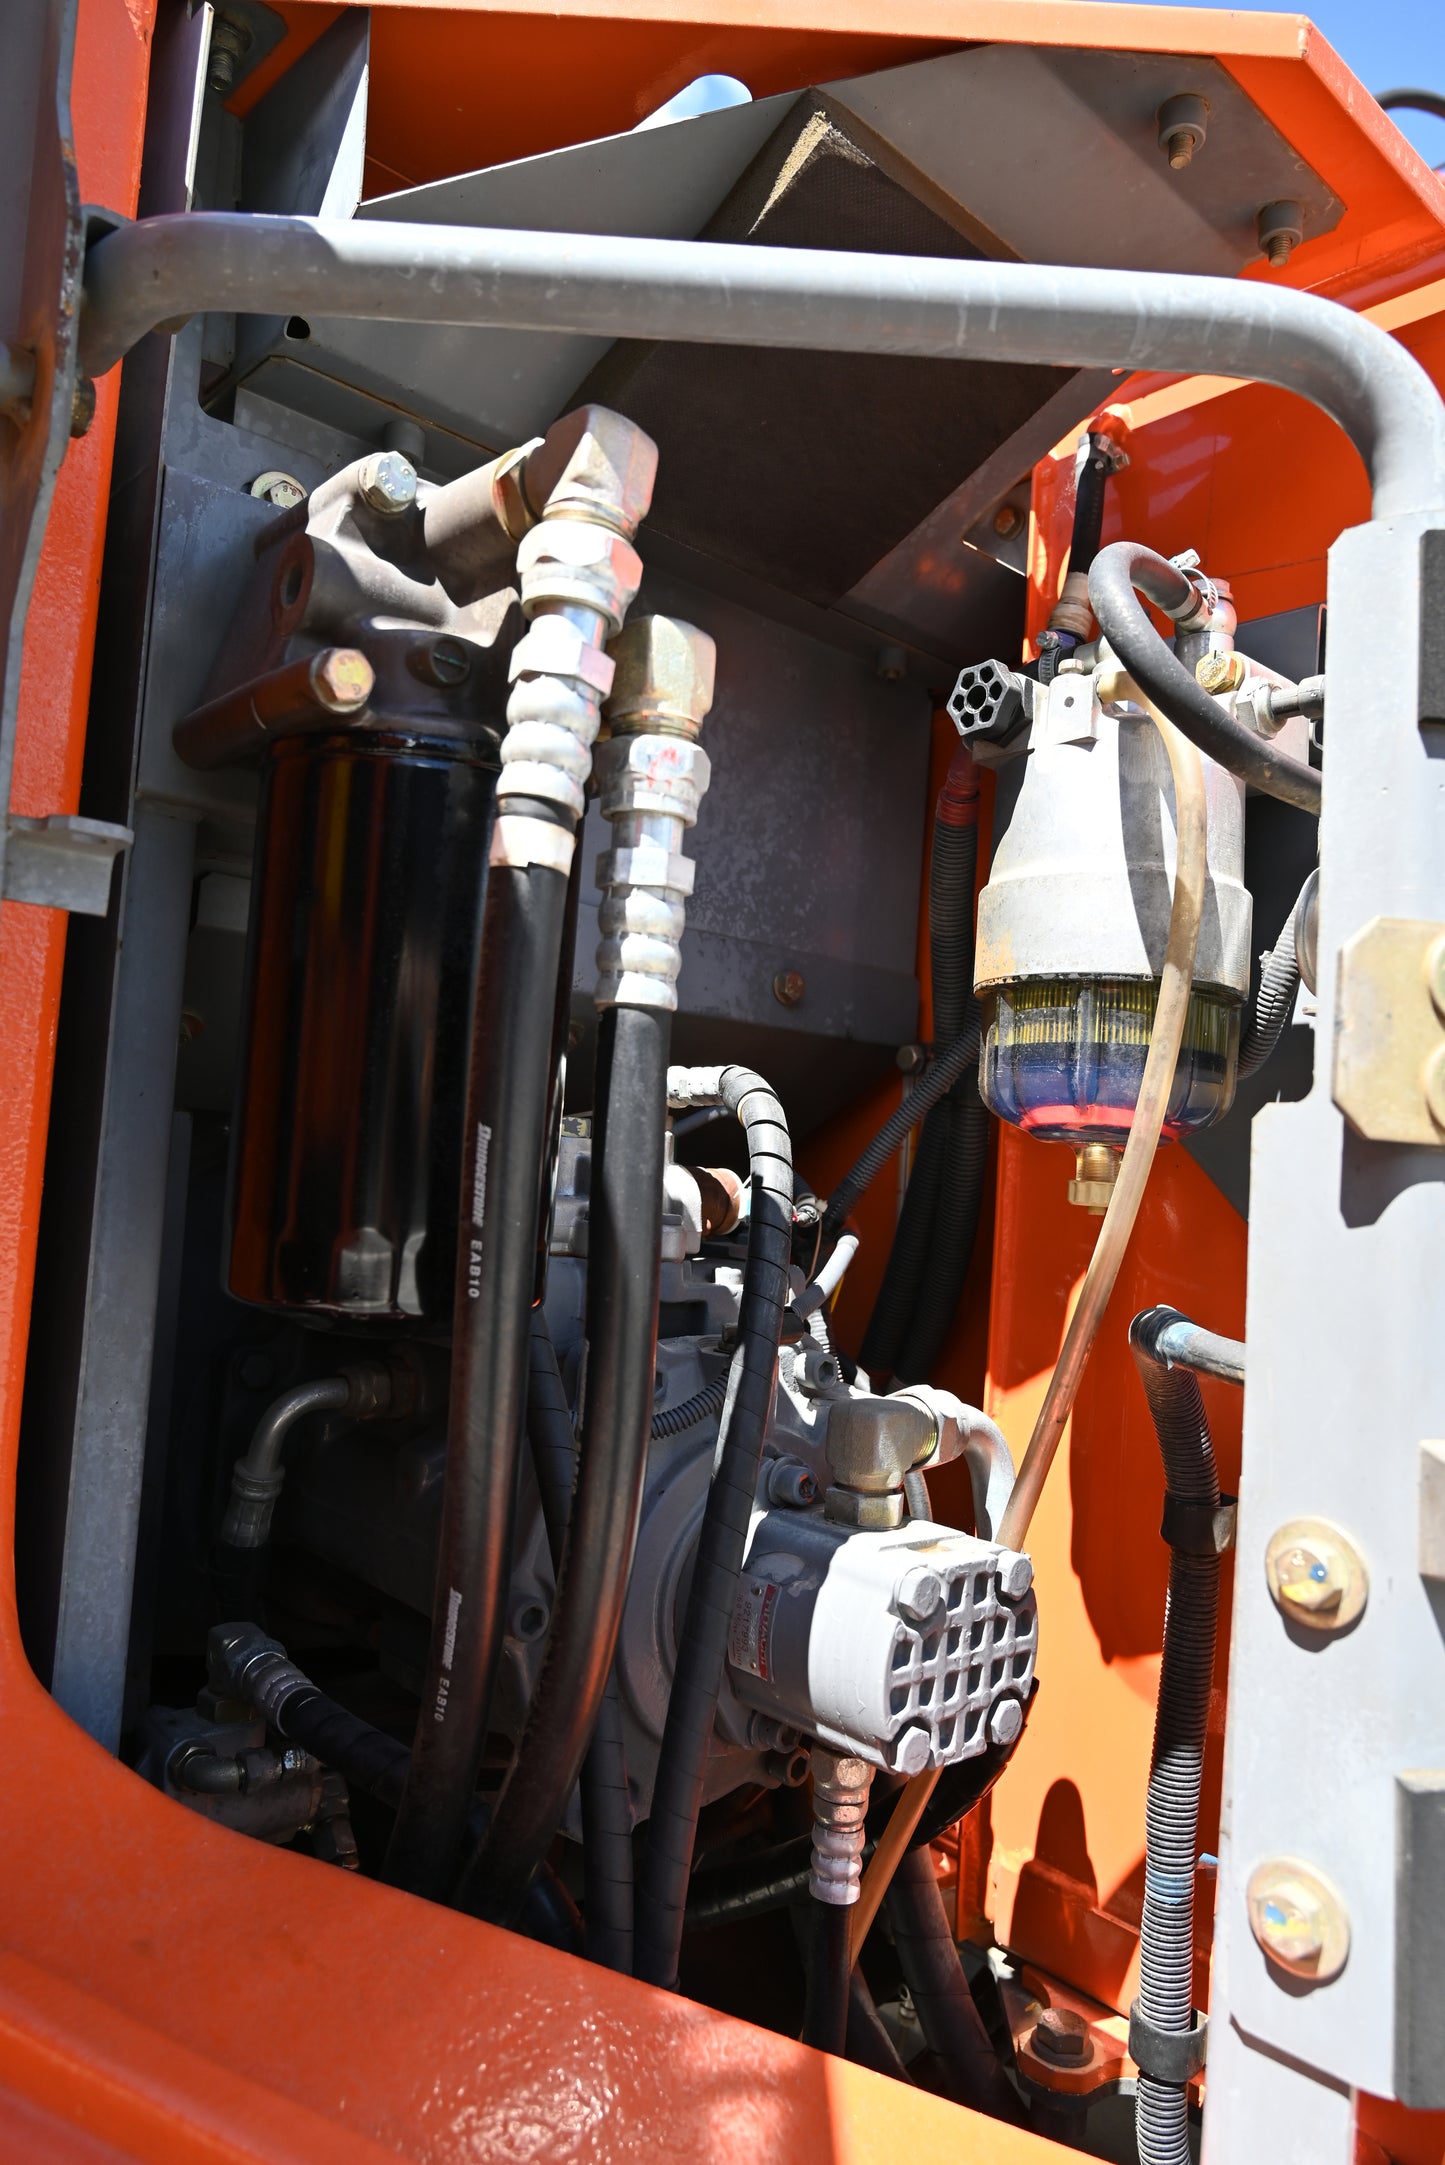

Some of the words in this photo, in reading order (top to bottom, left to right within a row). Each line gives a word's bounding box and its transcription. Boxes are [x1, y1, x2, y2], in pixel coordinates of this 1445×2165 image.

[472, 1122, 492, 1227] BRIDGESTONE
[468, 1240, 482, 1298] EAB10
[741, 1601, 752, 1653] 9217993
[434, 1677, 450, 1721] EAB10
